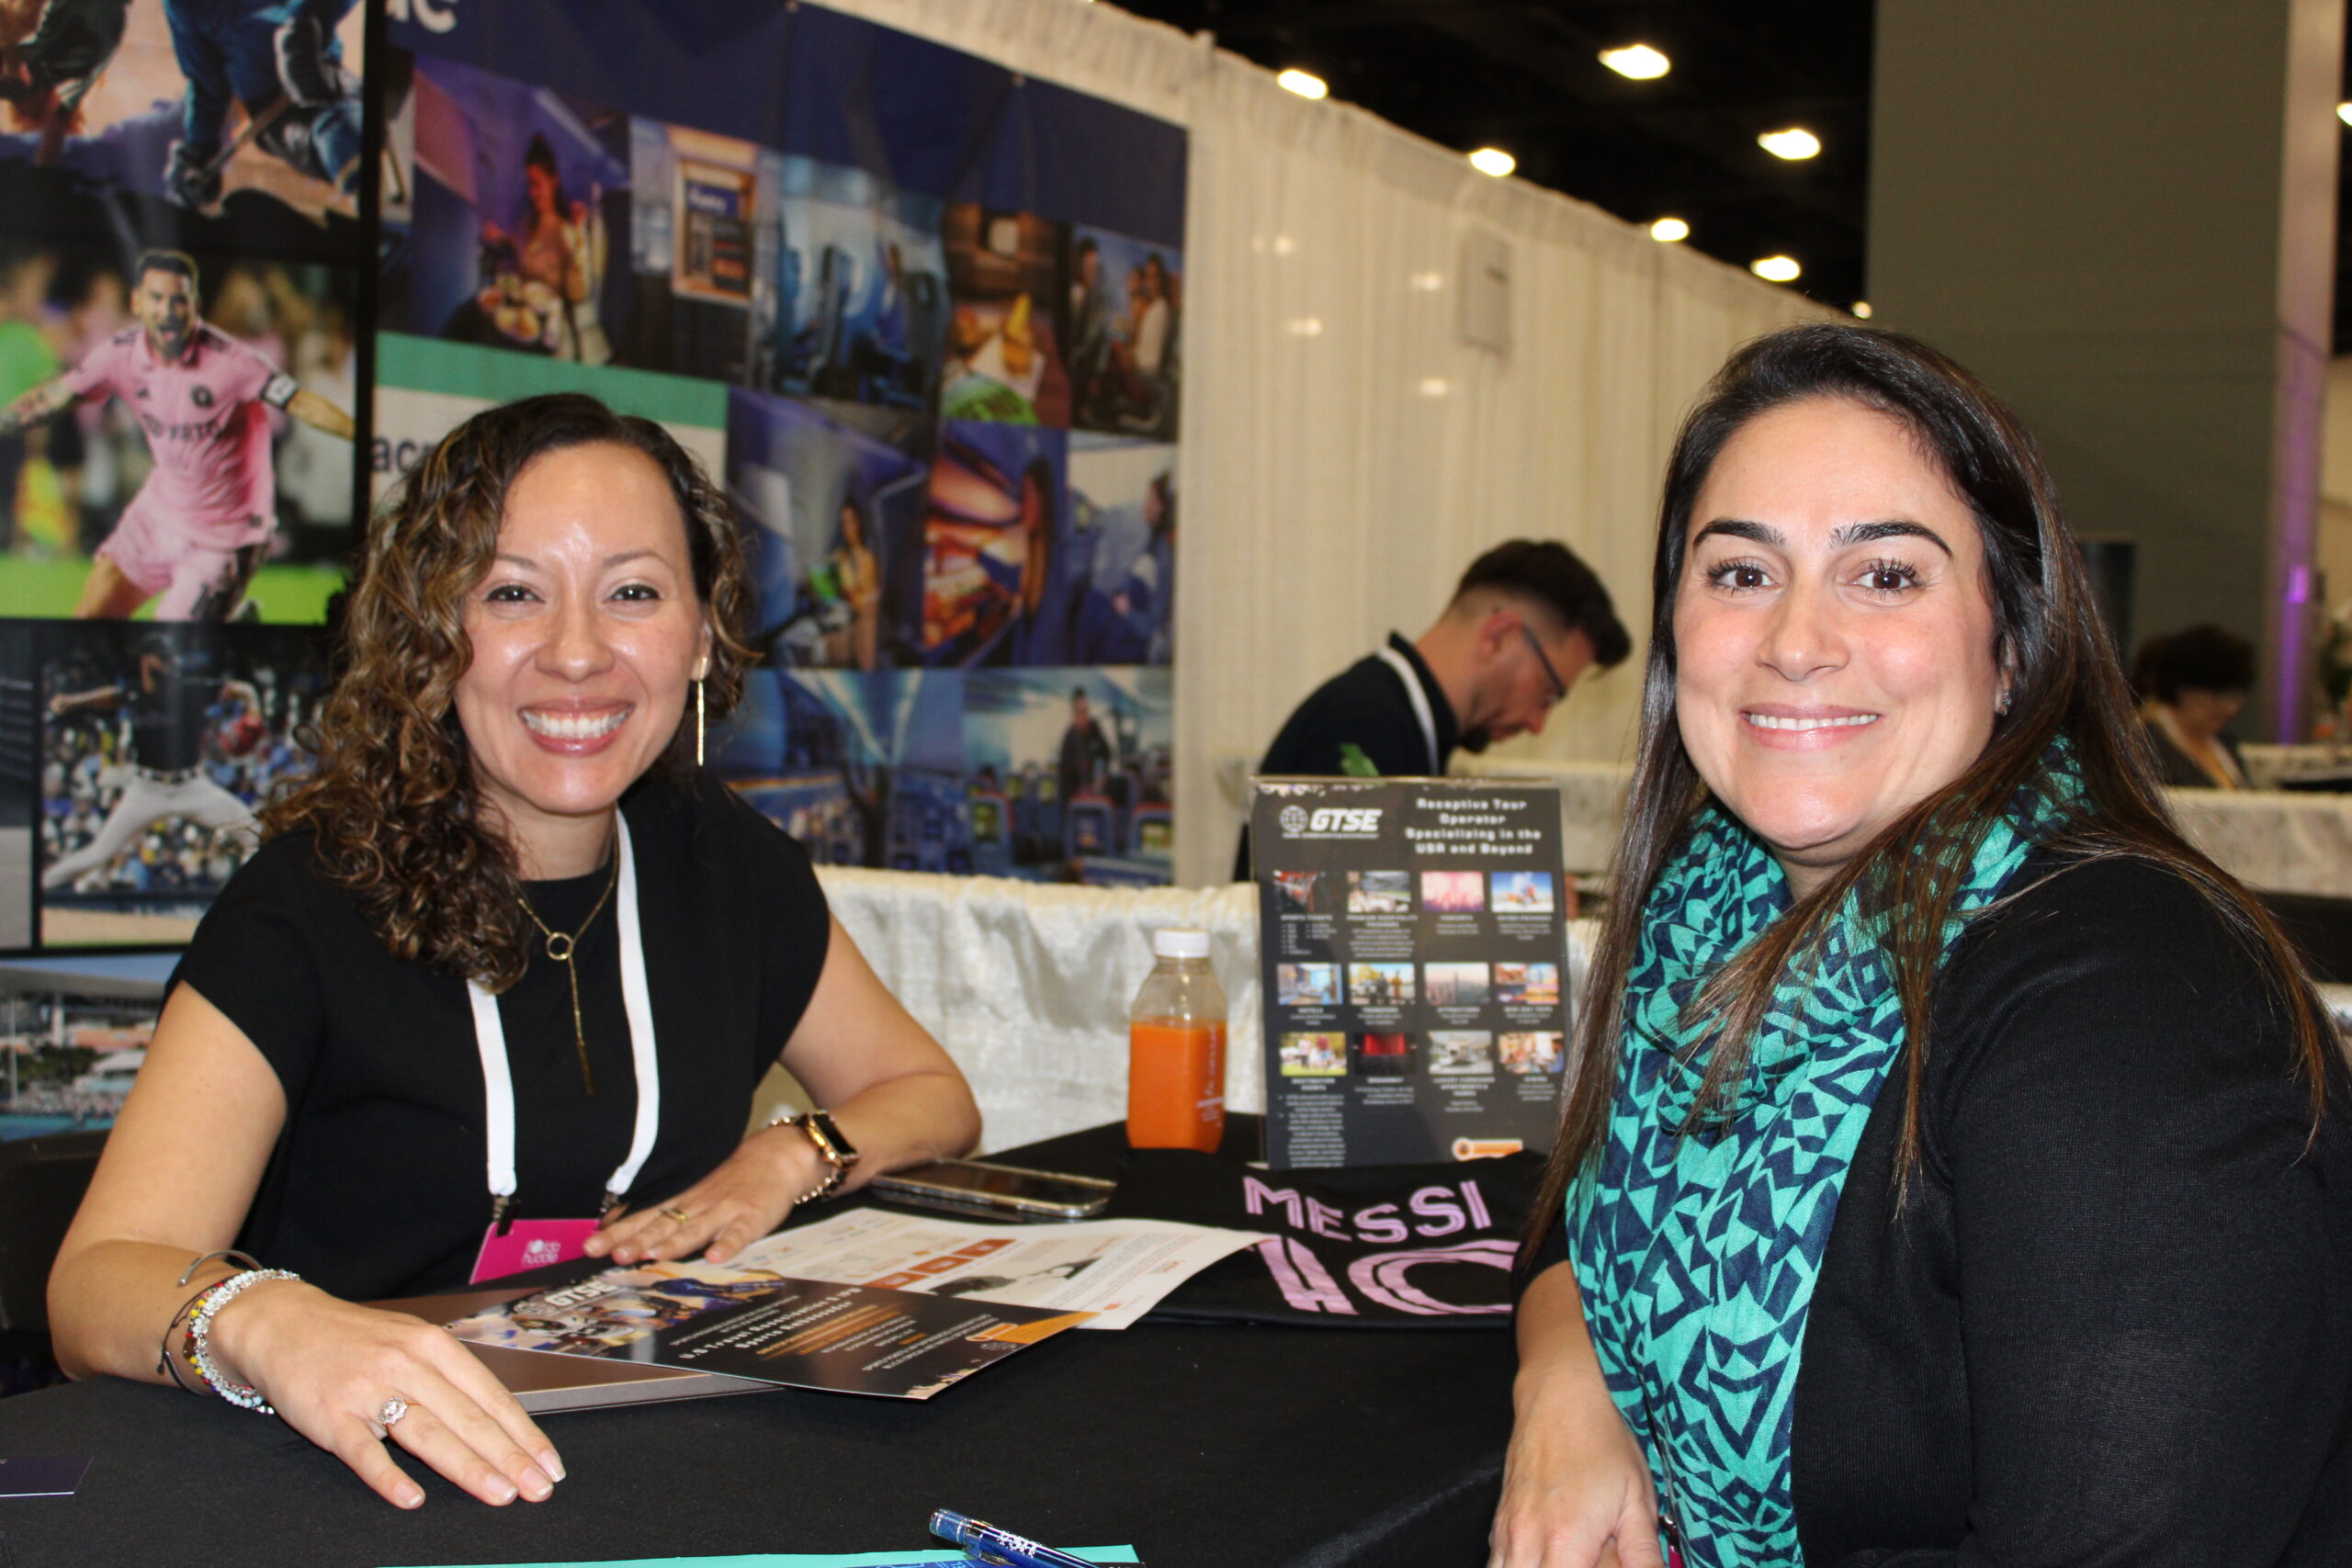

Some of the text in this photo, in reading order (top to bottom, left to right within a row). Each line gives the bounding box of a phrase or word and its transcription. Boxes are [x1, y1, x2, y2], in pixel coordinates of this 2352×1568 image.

[1416, 797, 1528, 811] Receptive Tour
[1310, 808, 1383, 832] GTSE
[1438, 813, 1507, 827] Operator
[1405, 828, 1542, 841] Specializing in the
[1415, 842, 1534, 856] USA and Beyond
[1242, 1176, 1492, 1243] MESSI
[545, 1280, 620, 1307] GTSE
